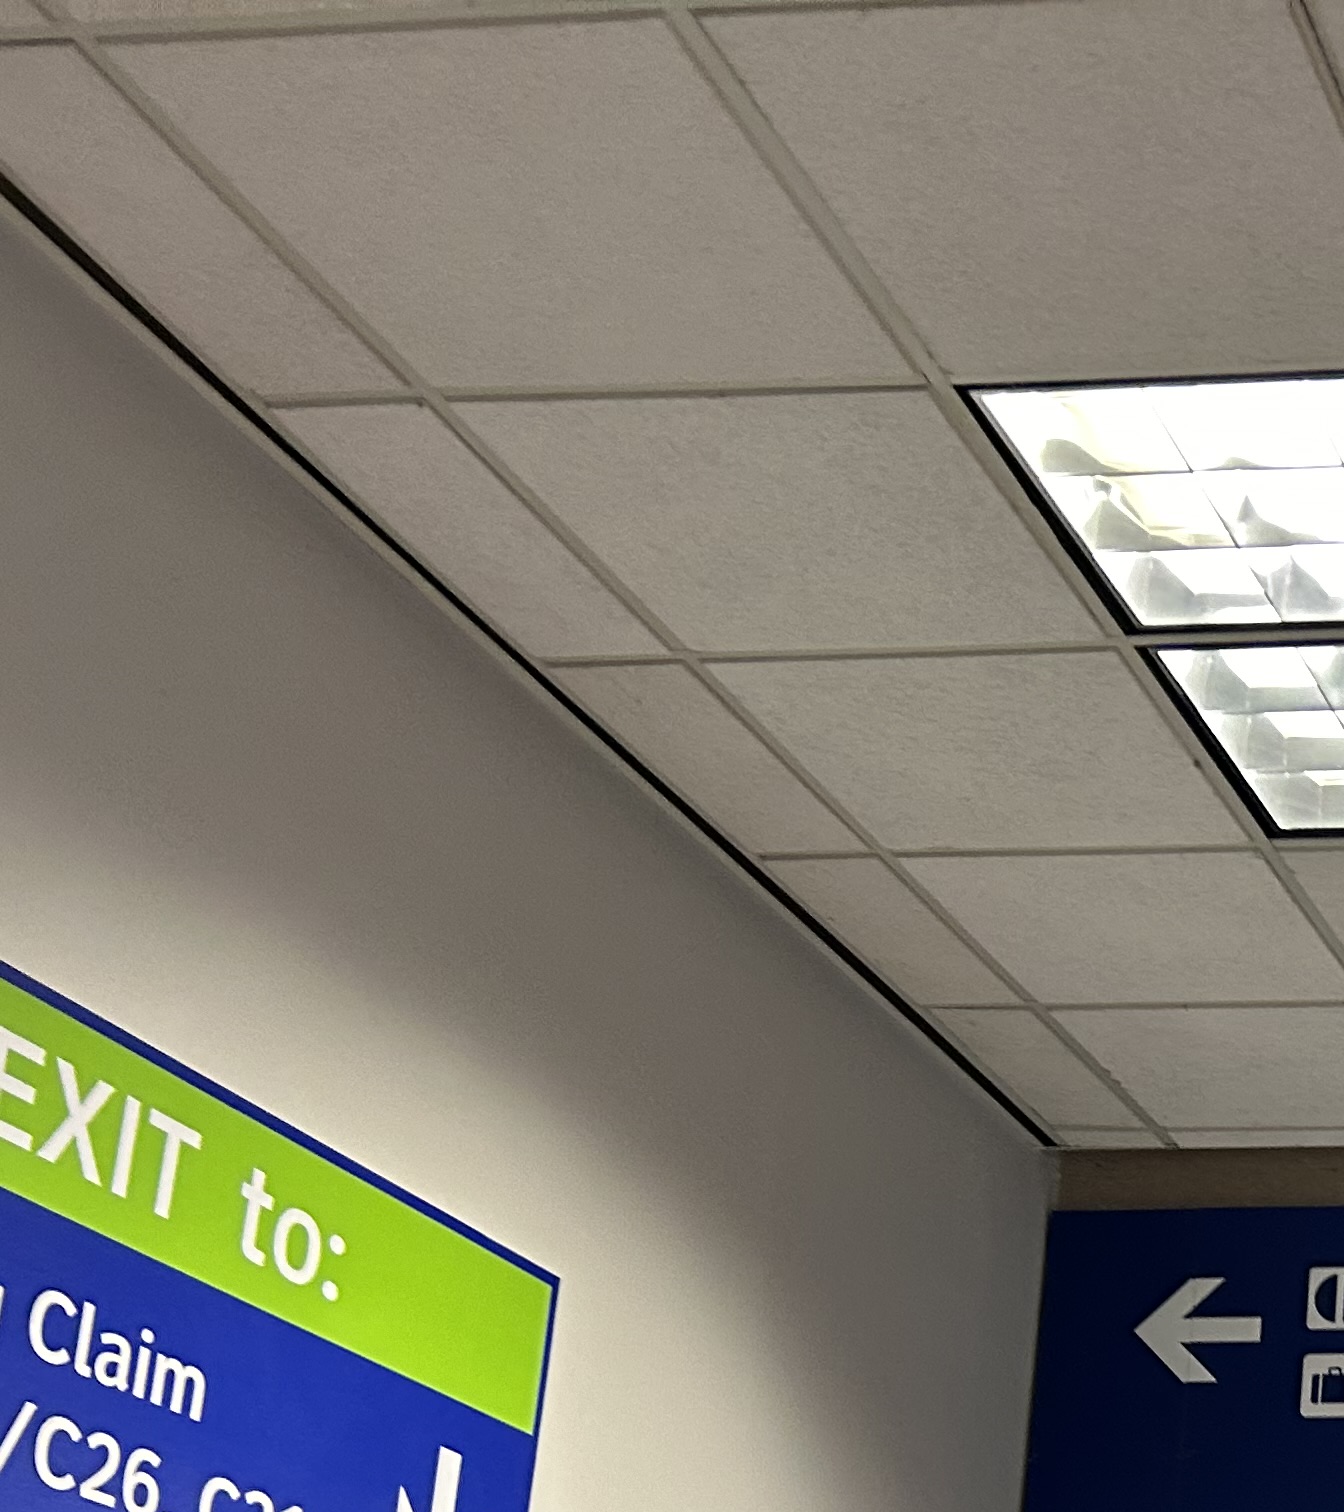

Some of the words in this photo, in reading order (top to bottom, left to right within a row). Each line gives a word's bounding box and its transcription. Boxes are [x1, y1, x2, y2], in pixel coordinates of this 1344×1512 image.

[0, 1026, 202, 1219] EXIT
[241, 1168, 346, 1302] to:
[29, 1289, 206, 1422] Claim
